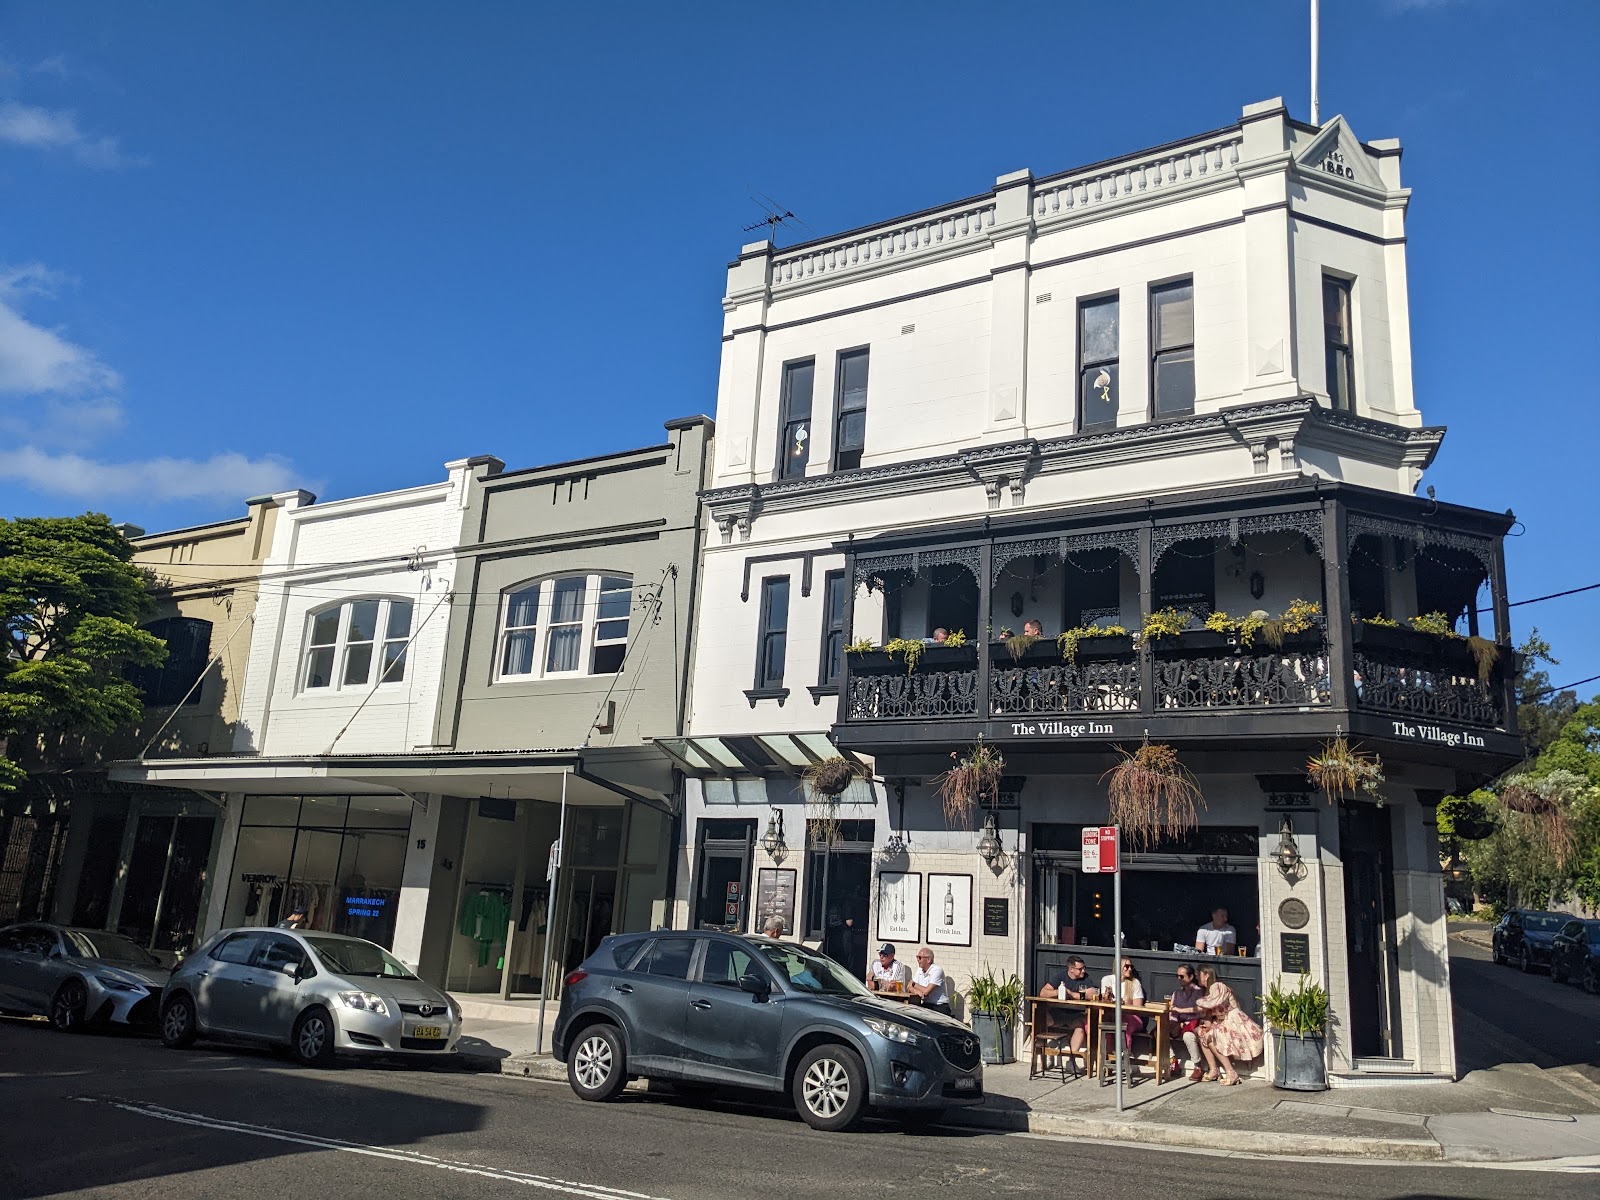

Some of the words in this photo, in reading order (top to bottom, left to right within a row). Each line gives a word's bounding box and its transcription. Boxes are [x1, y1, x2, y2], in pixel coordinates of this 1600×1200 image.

[1012, 723, 1035, 735] The
[1038, 722, 1085, 737] Village
[1088, 722, 1113, 734] Inn
[1392, 721, 1415, 737] The
[1417, 725, 1460, 746] Village
[1463, 732, 1484, 747] Inn
[416, 839, 426, 850] 15
[346, 896, 385, 906] MARRAKECH
[348, 908, 371, 917] SPRING
